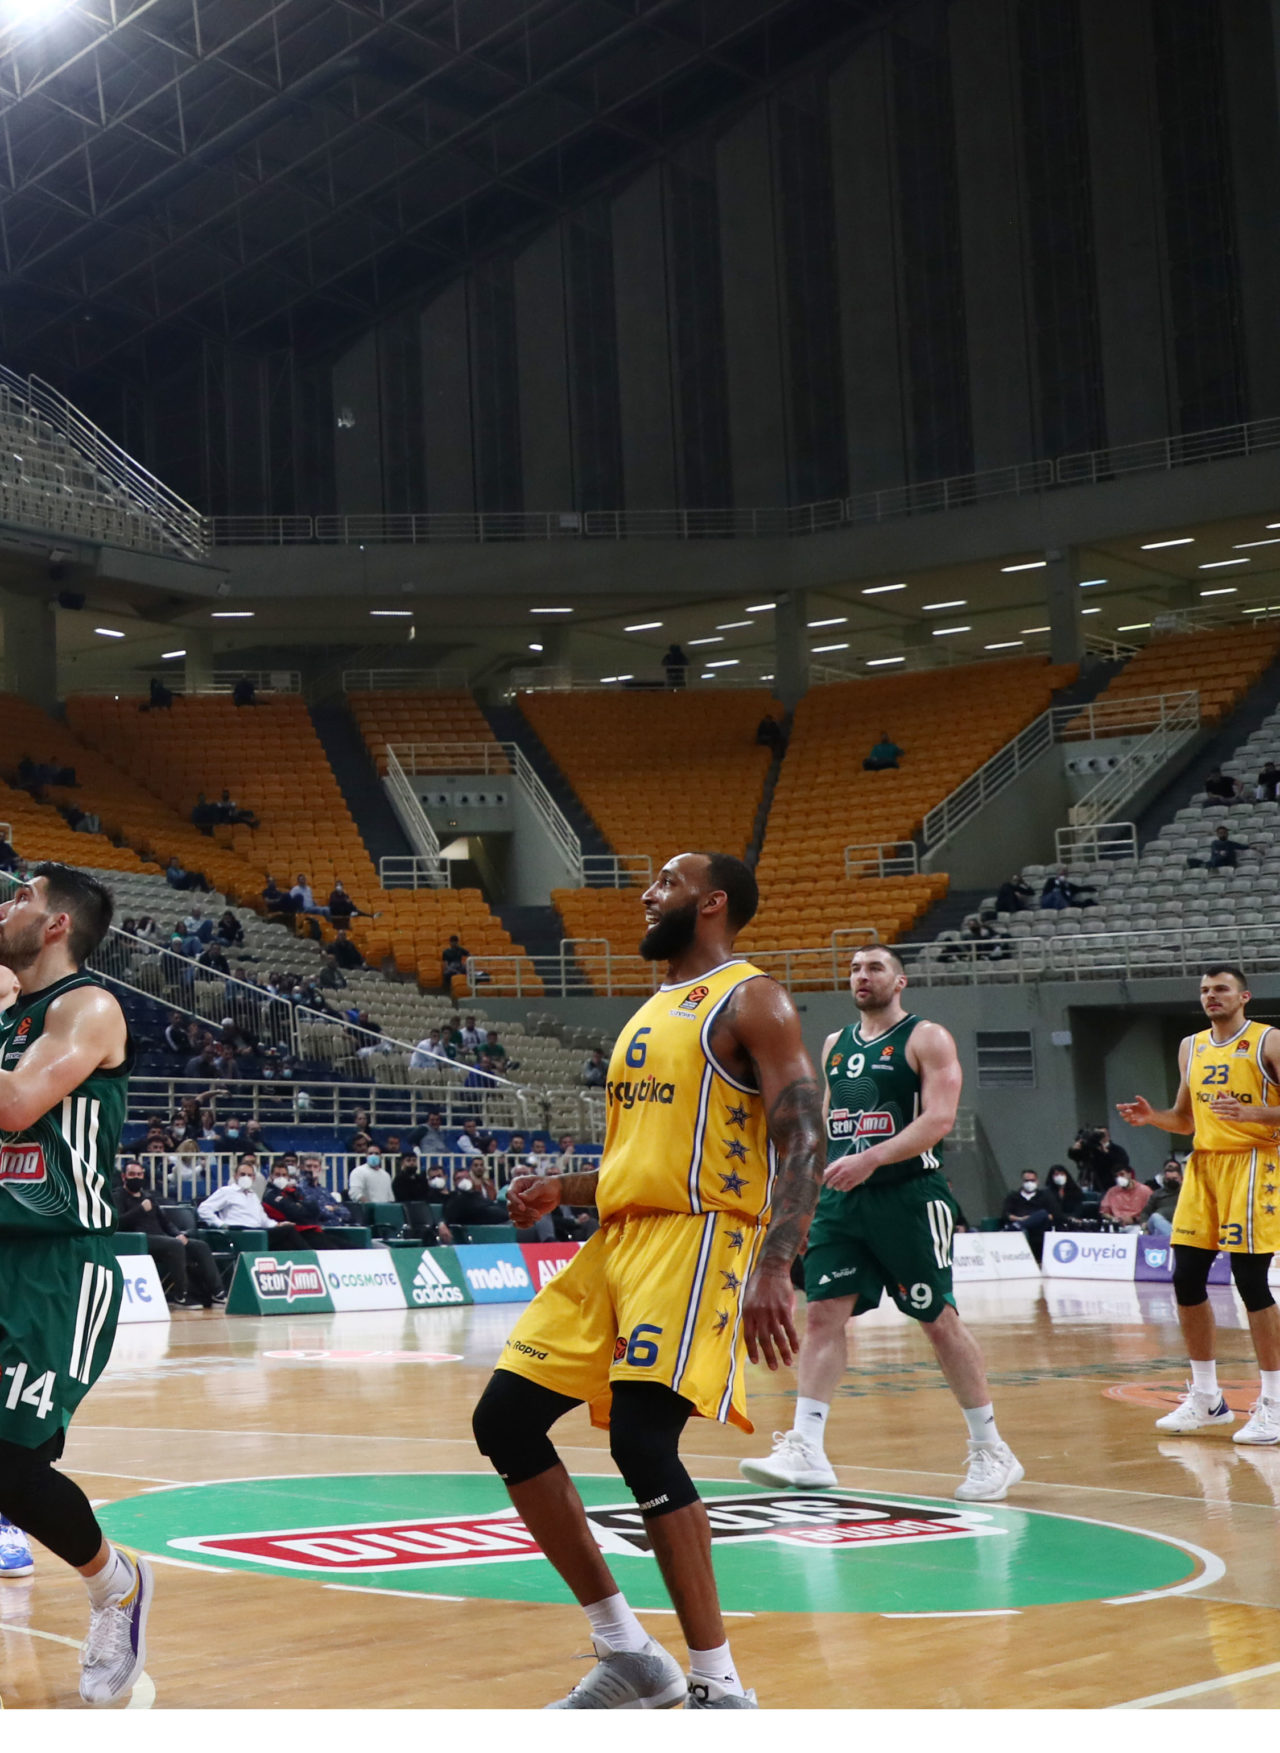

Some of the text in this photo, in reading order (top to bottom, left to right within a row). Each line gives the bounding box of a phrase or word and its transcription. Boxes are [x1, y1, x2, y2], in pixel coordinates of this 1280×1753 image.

[625, 1027, 652, 1068] 6
[846, 1053, 865, 1078] 9
[1202, 1064, 1229, 1084] 23
[1081, 1244, 1127, 1262] υγεία
[340, 1273, 397, 1287] COSMOTE
[466, 1259, 529, 1290] molto
[412, 1284, 464, 1304] adidas
[910, 1283, 933, 1309] 9
[514, 1340, 549, 1360] Rapyd
[626, 1323, 663, 1367] 6
[5, 1362, 57, 1419] 14
